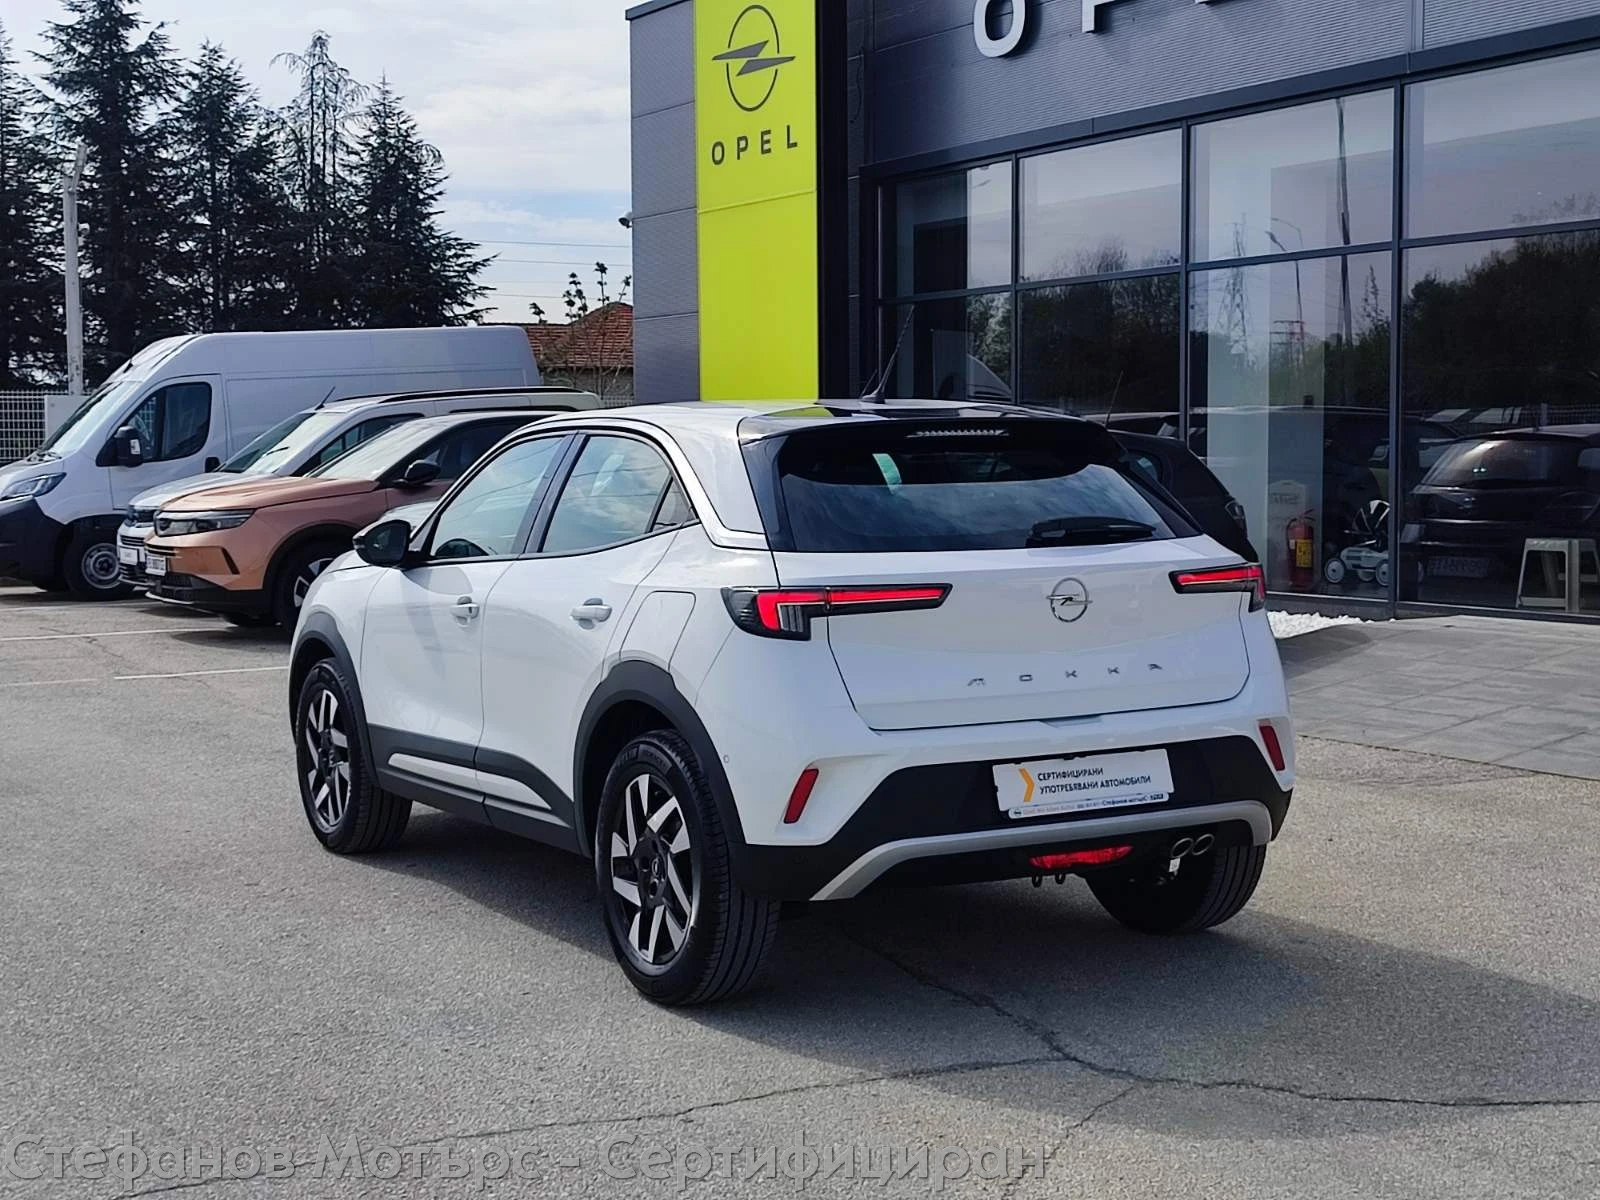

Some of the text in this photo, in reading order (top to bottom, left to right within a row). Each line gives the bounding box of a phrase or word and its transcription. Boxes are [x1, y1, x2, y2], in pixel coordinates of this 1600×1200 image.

[711, 124, 798, 166] OPEL
[1037, 767, 1104, 782] СЕРТИФИЦИРАНИ
[1039, 775, 1152, 795] УПОТРЕБЯВАНИ АВТОМОБИЛИ
